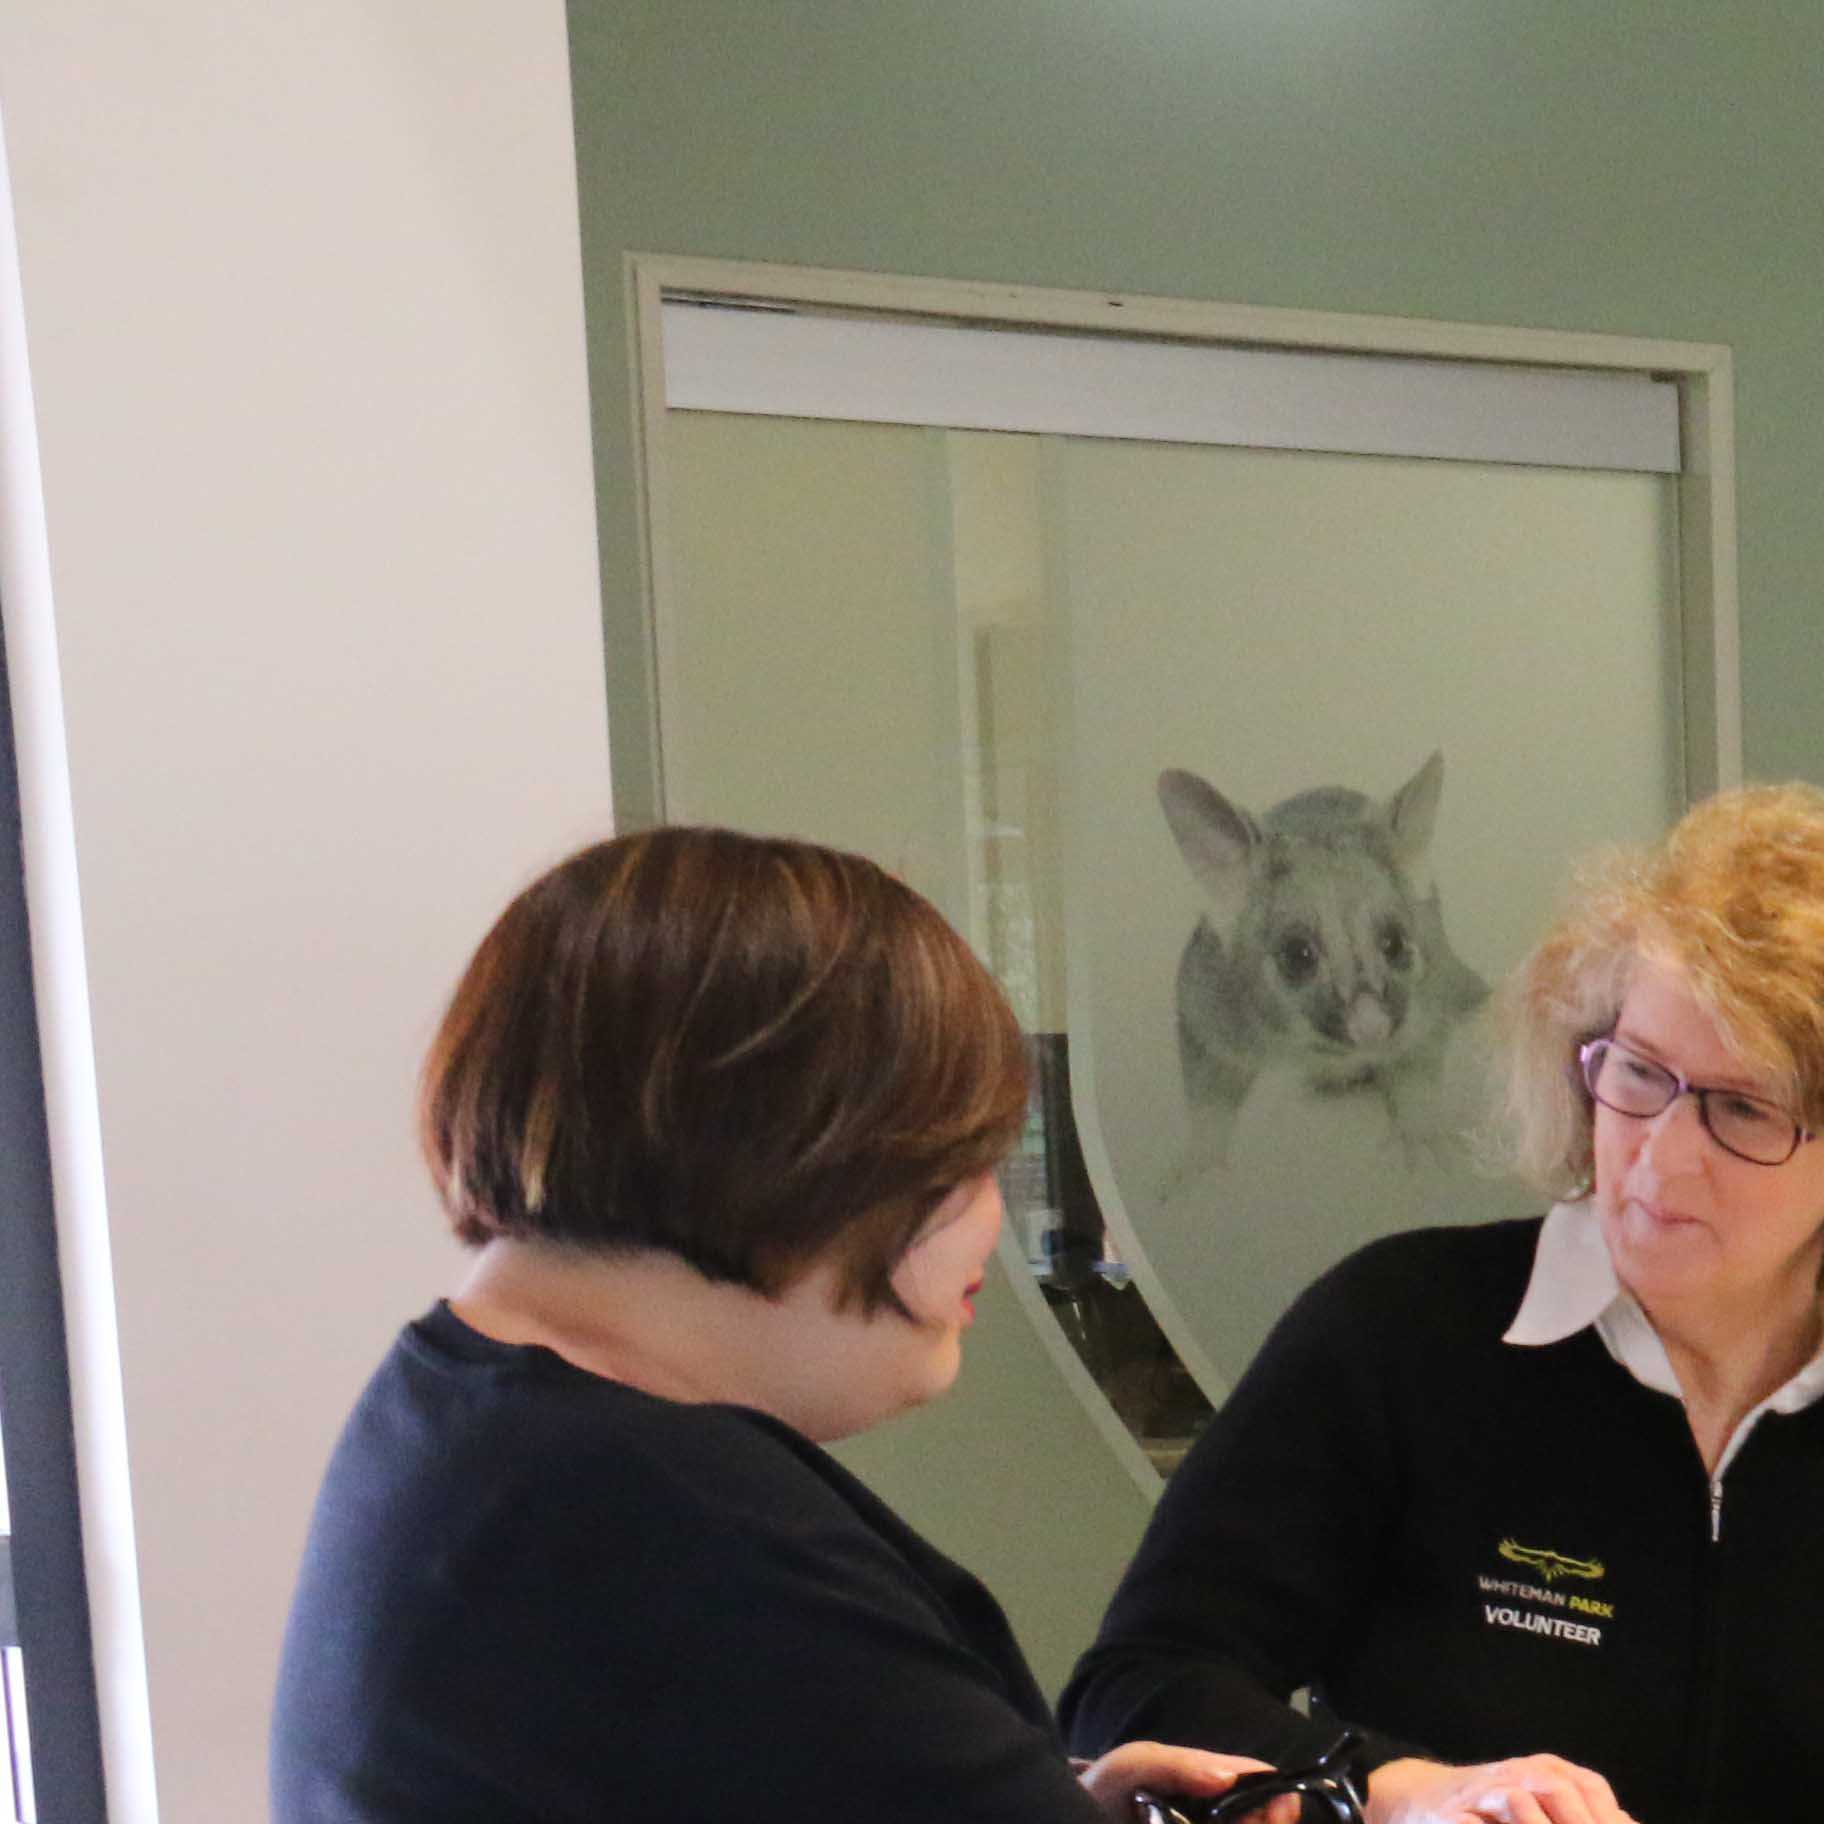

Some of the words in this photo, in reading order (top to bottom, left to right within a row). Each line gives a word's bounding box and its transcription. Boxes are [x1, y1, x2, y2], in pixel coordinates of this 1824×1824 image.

[1478, 1576, 1565, 1606] WHITEMAN
[1568, 1596, 1614, 1618] PARK
[1484, 1605, 1601, 1646] VOLUNTEER
